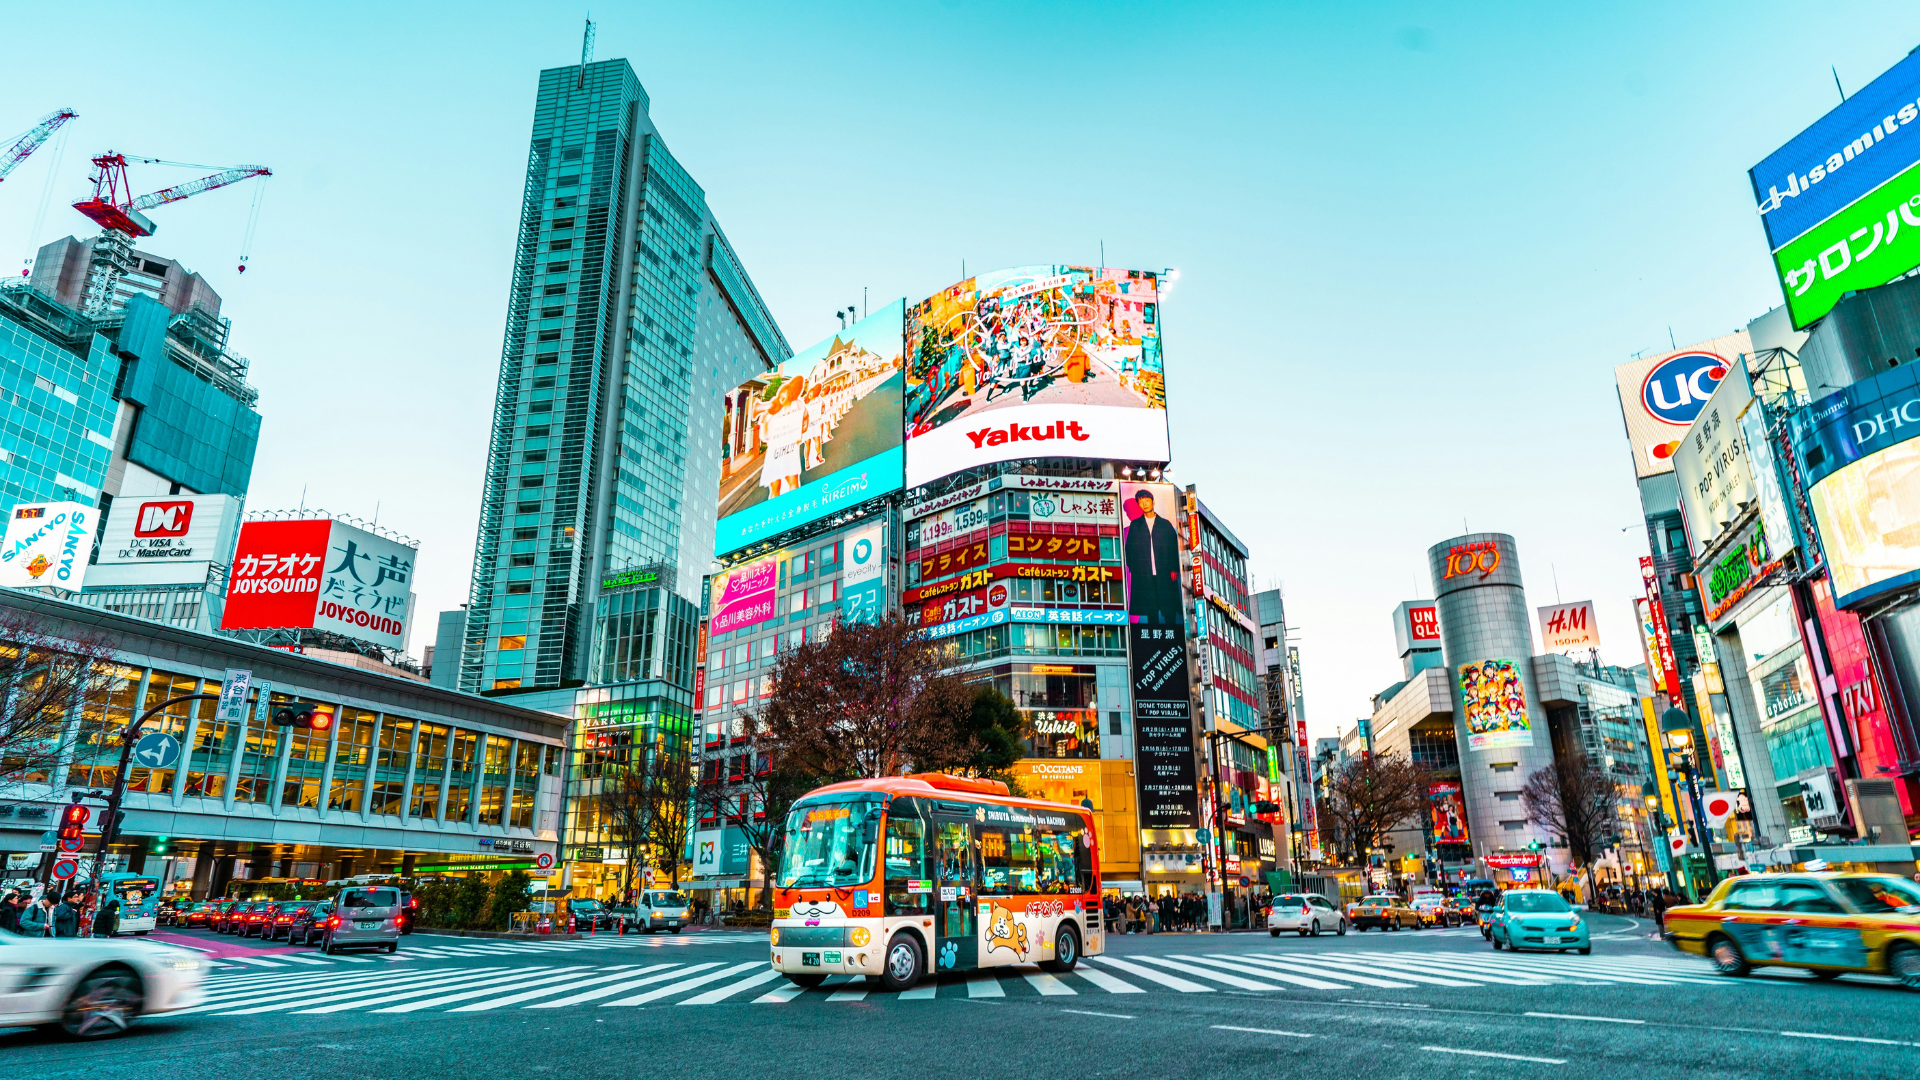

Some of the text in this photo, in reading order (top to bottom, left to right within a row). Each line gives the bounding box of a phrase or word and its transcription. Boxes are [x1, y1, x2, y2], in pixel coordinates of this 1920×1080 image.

[1756, 97, 1920, 216] Hisamits
[1811, 396, 1849, 424] Channel
[1695, 407, 1721, 455] 星野源
[1852, 398, 1920, 445] DHC
[965, 420, 1090, 449] Yakult
[822, 477, 868, 505] KIREIMO
[1020, 477, 1113, 490] しゃぶしゃぶバイキング
[912, 485, 982, 517] しゃぶしゃぶバイキング
[1060, 498, 1115, 516] しゃぶ葉
[139, 505, 187, 532] DC
[955, 509, 989, 532] 1,599円
[2, 513, 66, 562] SANKYO
[907, 529, 919, 542] 9F
[923, 521, 953, 543] 1,199円
[57, 511, 88, 581] SANKYO
[118, 547, 192, 558] DC MasterCard
[130, 539, 186, 548] DC VISA &
[1009, 536, 1097, 555] コンタクト
[1450, 541, 1497, 554] SHIBUYA
[236, 553, 321, 577] カラオケ
[326, 540, 412, 587] 大声
[922, 543, 987, 576] プライス
[1443, 547, 1501, 580] 109
[603, 573, 657, 586] MARK CITY
[741, 563, 774, 583] 品川スキン
[847, 563, 877, 579] eyecity
[960, 569, 994, 591] ガスト
[1072, 565, 1113, 582] ガスト
[232, 577, 318, 594] JOYSOUND
[739, 575, 769, 594] クリニック
[322, 576, 405, 620] だそうぜ。
[942, 594, 984, 622] ガスト
[318, 600, 403, 636] JOYSOUND
[720, 600, 772, 629] 品川美容外科
[1015, 611, 1041, 619] AEON
[1048, 611, 1126, 623] 英会話イーオン
[1546, 606, 1587, 635] H&M
[930, 616, 989, 638] 英会話イーオン
[1141, 628, 1175, 639] 星野源
[1554, 637, 1580, 646] 150m
[223, 679, 233, 700] Shibuya
[1152, 678, 1165, 692] NOW
[1163, 670, 1172, 680] ON
[228, 673, 247, 718] 渋谷駅前
[580, 713, 655, 727] MARK CITY
[598, 709, 634, 717] SHIBUYA
[1035, 719, 1078, 734] Ushi8
[1032, 764, 1084, 774] L'OCCITANE
[988, 810, 1010, 822] SHIBUYA
[1011, 813, 1036, 826] community
[1037, 814, 1046, 824] bus
[1259, 838, 1275, 856] LUSH
[852, 909, 871, 917] D209
[1025, 899, 1064, 918] ハチ公バス
